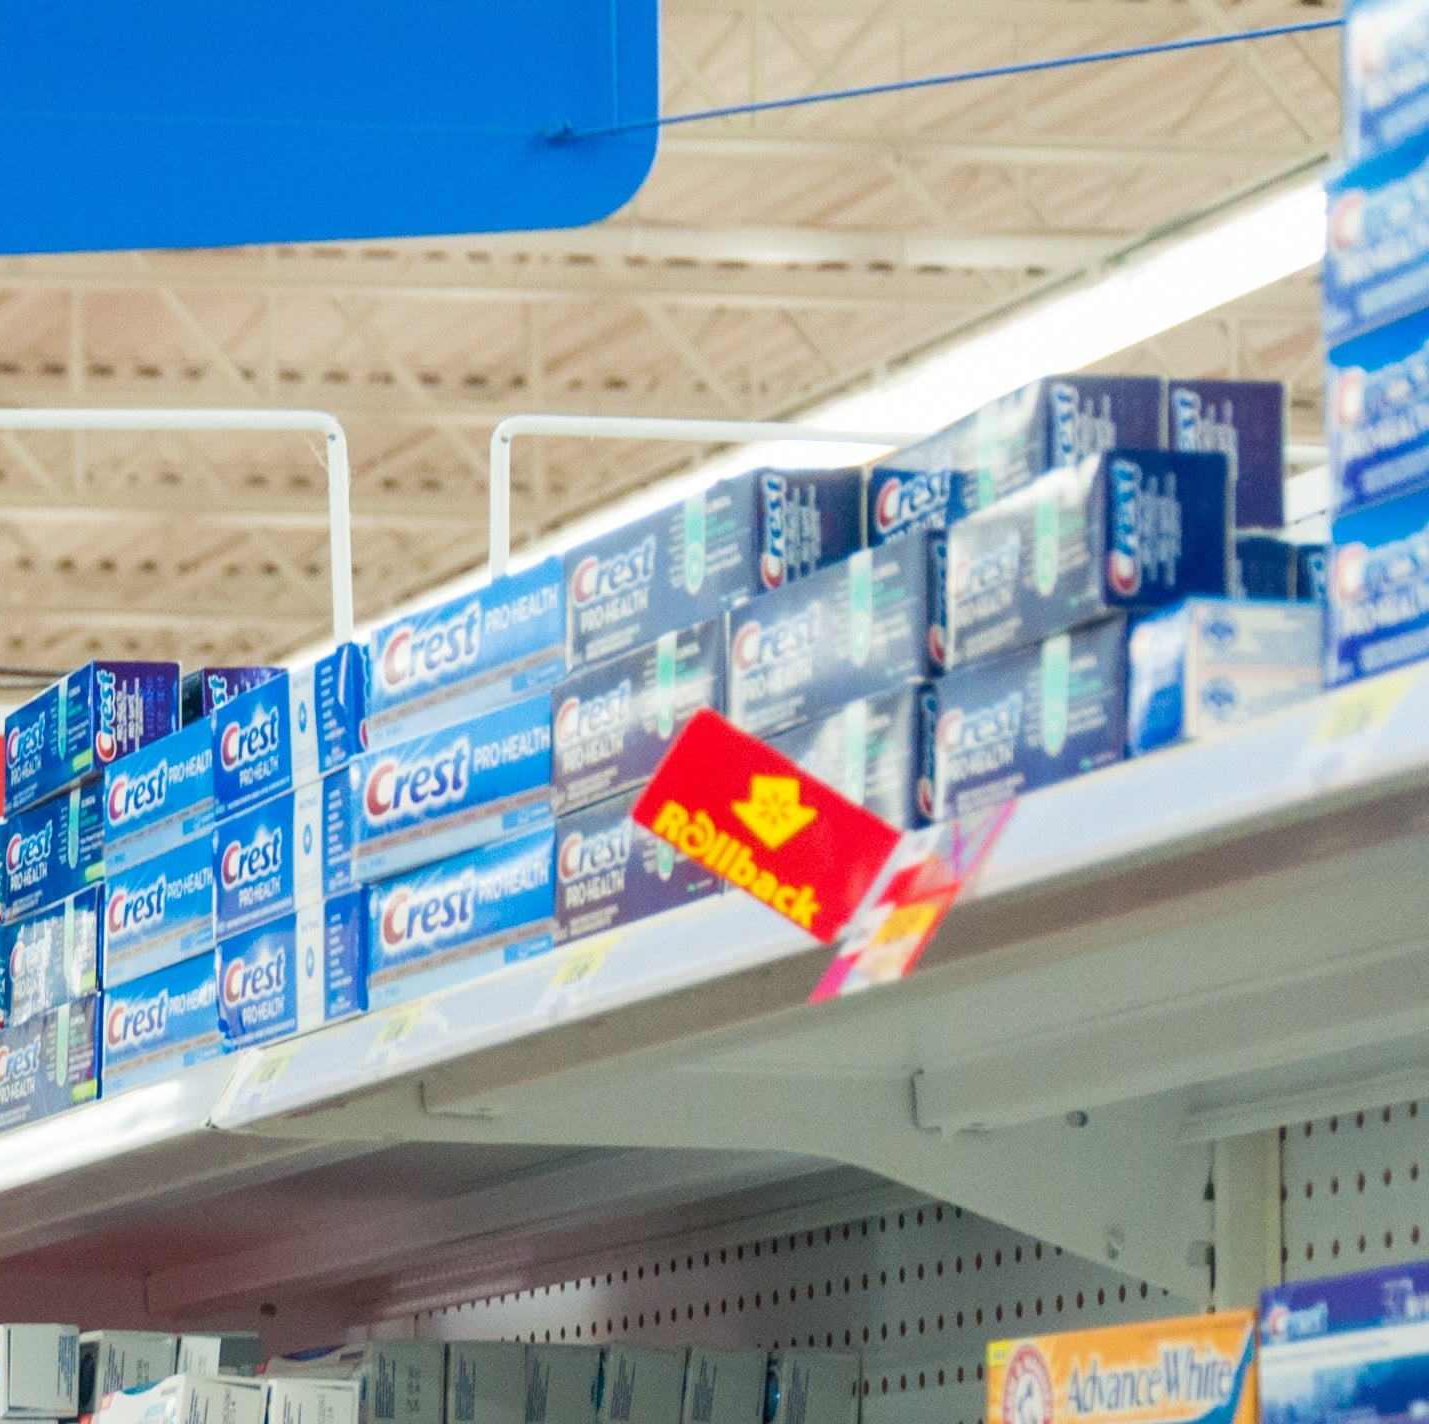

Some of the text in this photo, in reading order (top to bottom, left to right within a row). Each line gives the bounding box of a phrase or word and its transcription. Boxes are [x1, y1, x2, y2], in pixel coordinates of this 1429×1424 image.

[761, 474, 787, 589] Crest
[875, 467, 951, 534] Crest
[573, 533, 657, 604] Crest
[382, 600, 483, 693] Crest
[5, 712, 46, 769] Crest
[96, 671, 117, 762] Crest
[221, 708, 281, 774] Crest
[108, 758, 167, 820] Crest
[366, 735, 470, 821] Crest
[5, 816, 54, 876] Crest
[221, 827, 282, 889] Crest
[559, 822, 633, 881] Crest
[652, 799, 822, 930] Rollback
[108, 874, 167, 936] Crest
[382, 869, 475, 950] Crest
[225, 949, 285, 1008] Crest
[108, 986, 169, 1047] Crest
